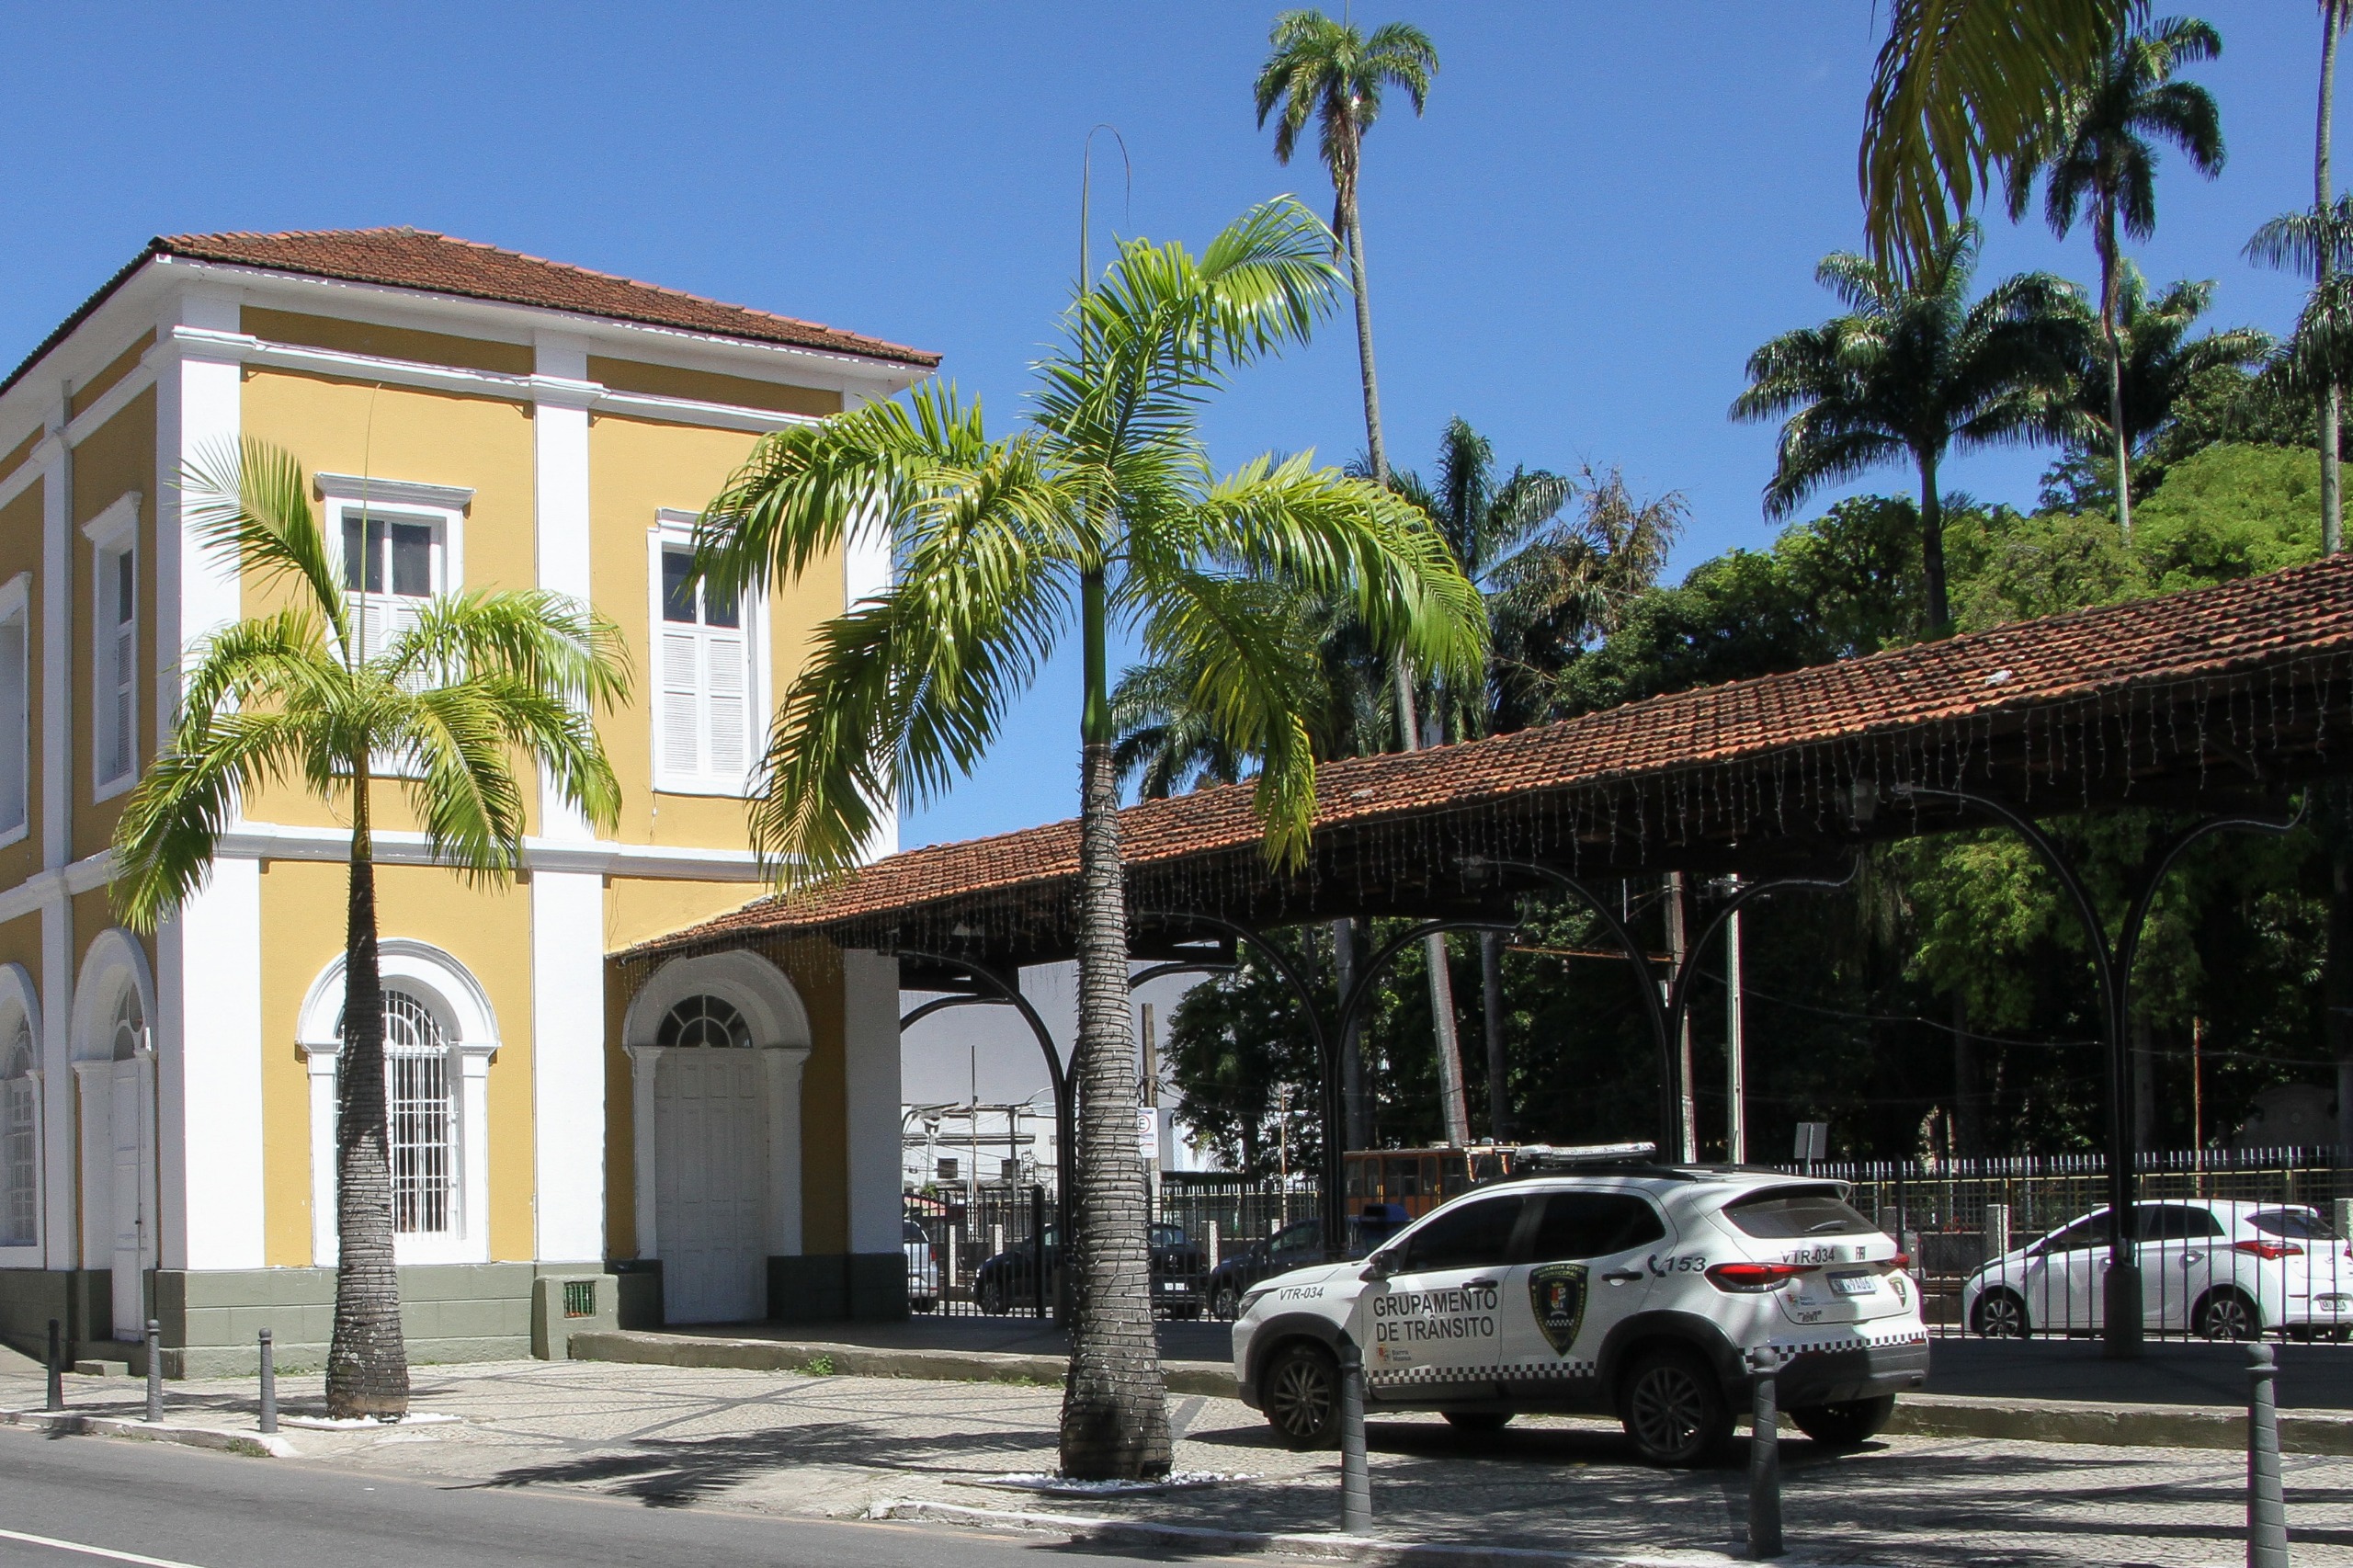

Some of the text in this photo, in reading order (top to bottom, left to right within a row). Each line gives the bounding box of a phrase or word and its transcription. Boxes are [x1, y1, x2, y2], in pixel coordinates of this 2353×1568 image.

[1665, 1256, 1707, 1272] 153
[1780, 1247, 1836, 1264] VTR-034
[1279, 1286, 1324, 1301] VTR-034
[1372, 1289, 1498, 1318] GRUPAMENTO
[1376, 1314, 1495, 1343] DE TRÂNSITO
